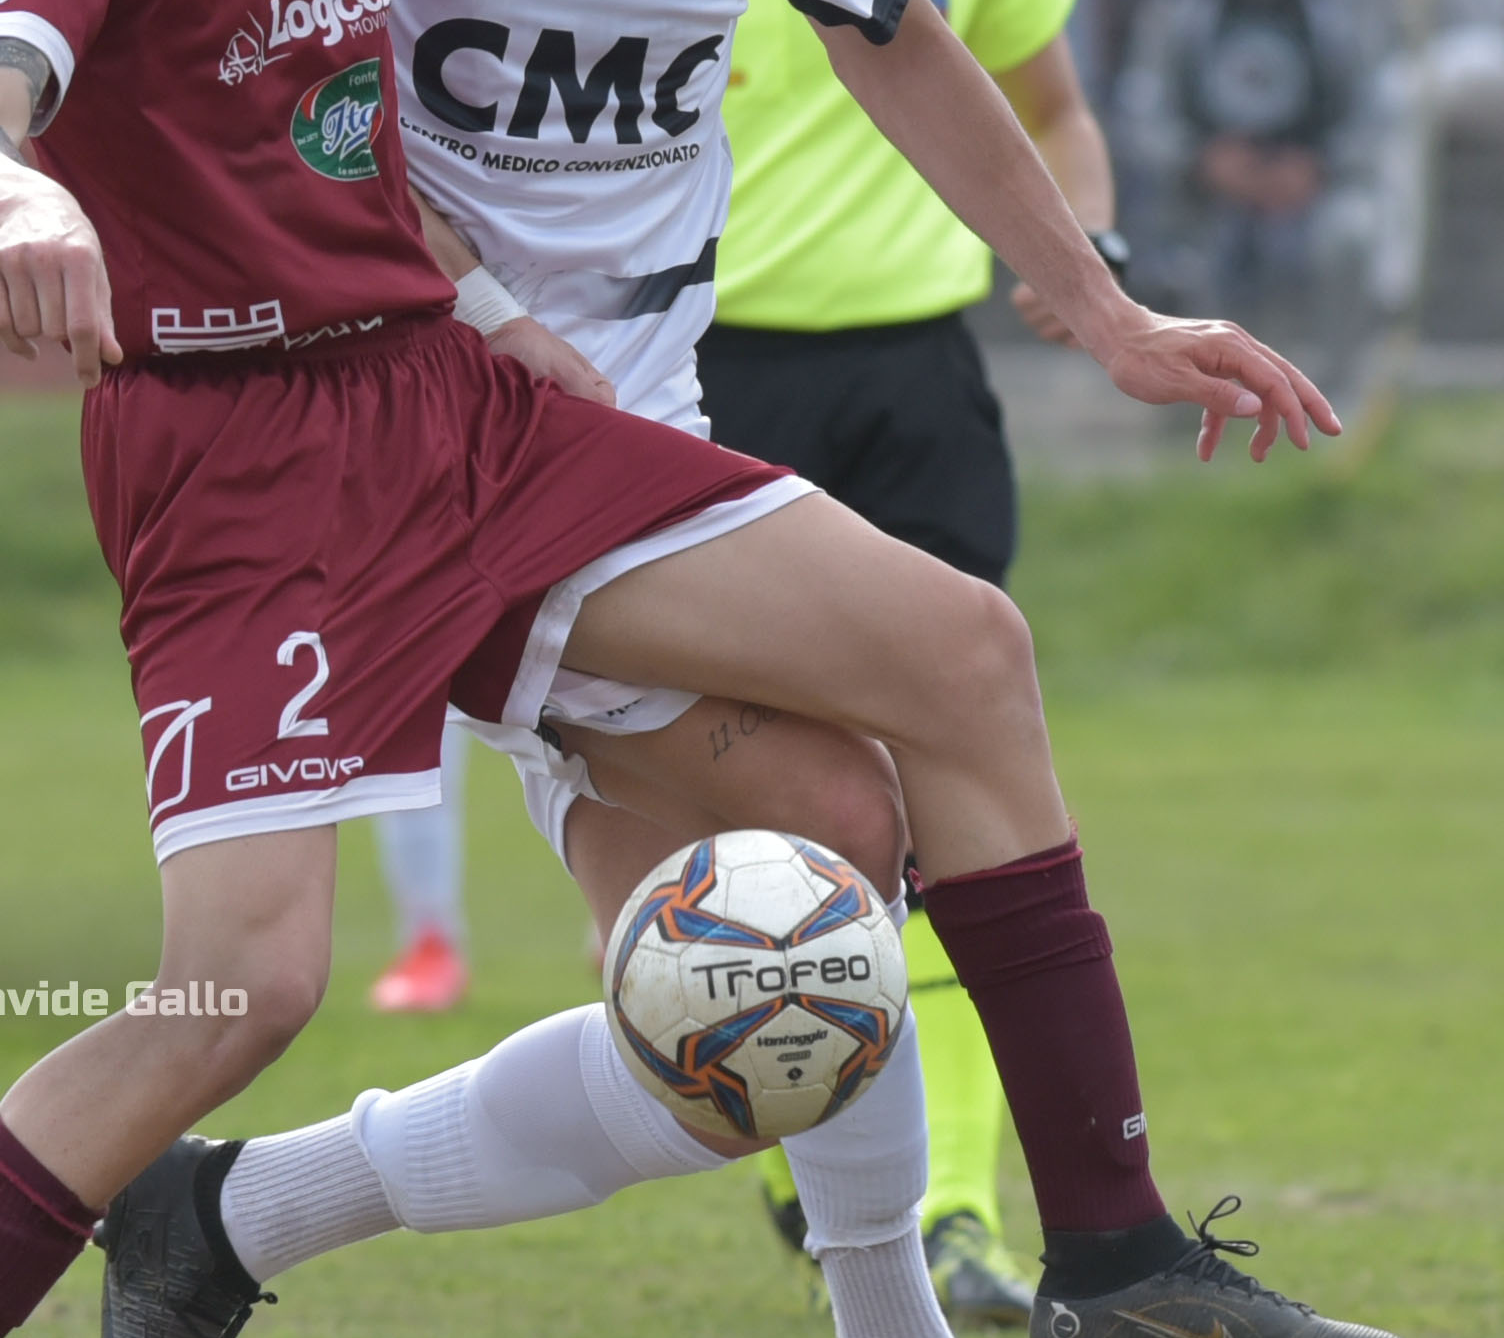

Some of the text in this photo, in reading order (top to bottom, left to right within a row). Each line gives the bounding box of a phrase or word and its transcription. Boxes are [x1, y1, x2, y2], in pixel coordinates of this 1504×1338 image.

[412, 18, 725, 145] CMC
[482, 151, 559, 173] MEDICO
[564, 143, 700, 172] CONVENZIONATO
[277, 630, 330, 740] 2
[225, 755, 364, 792] GIVOVA
